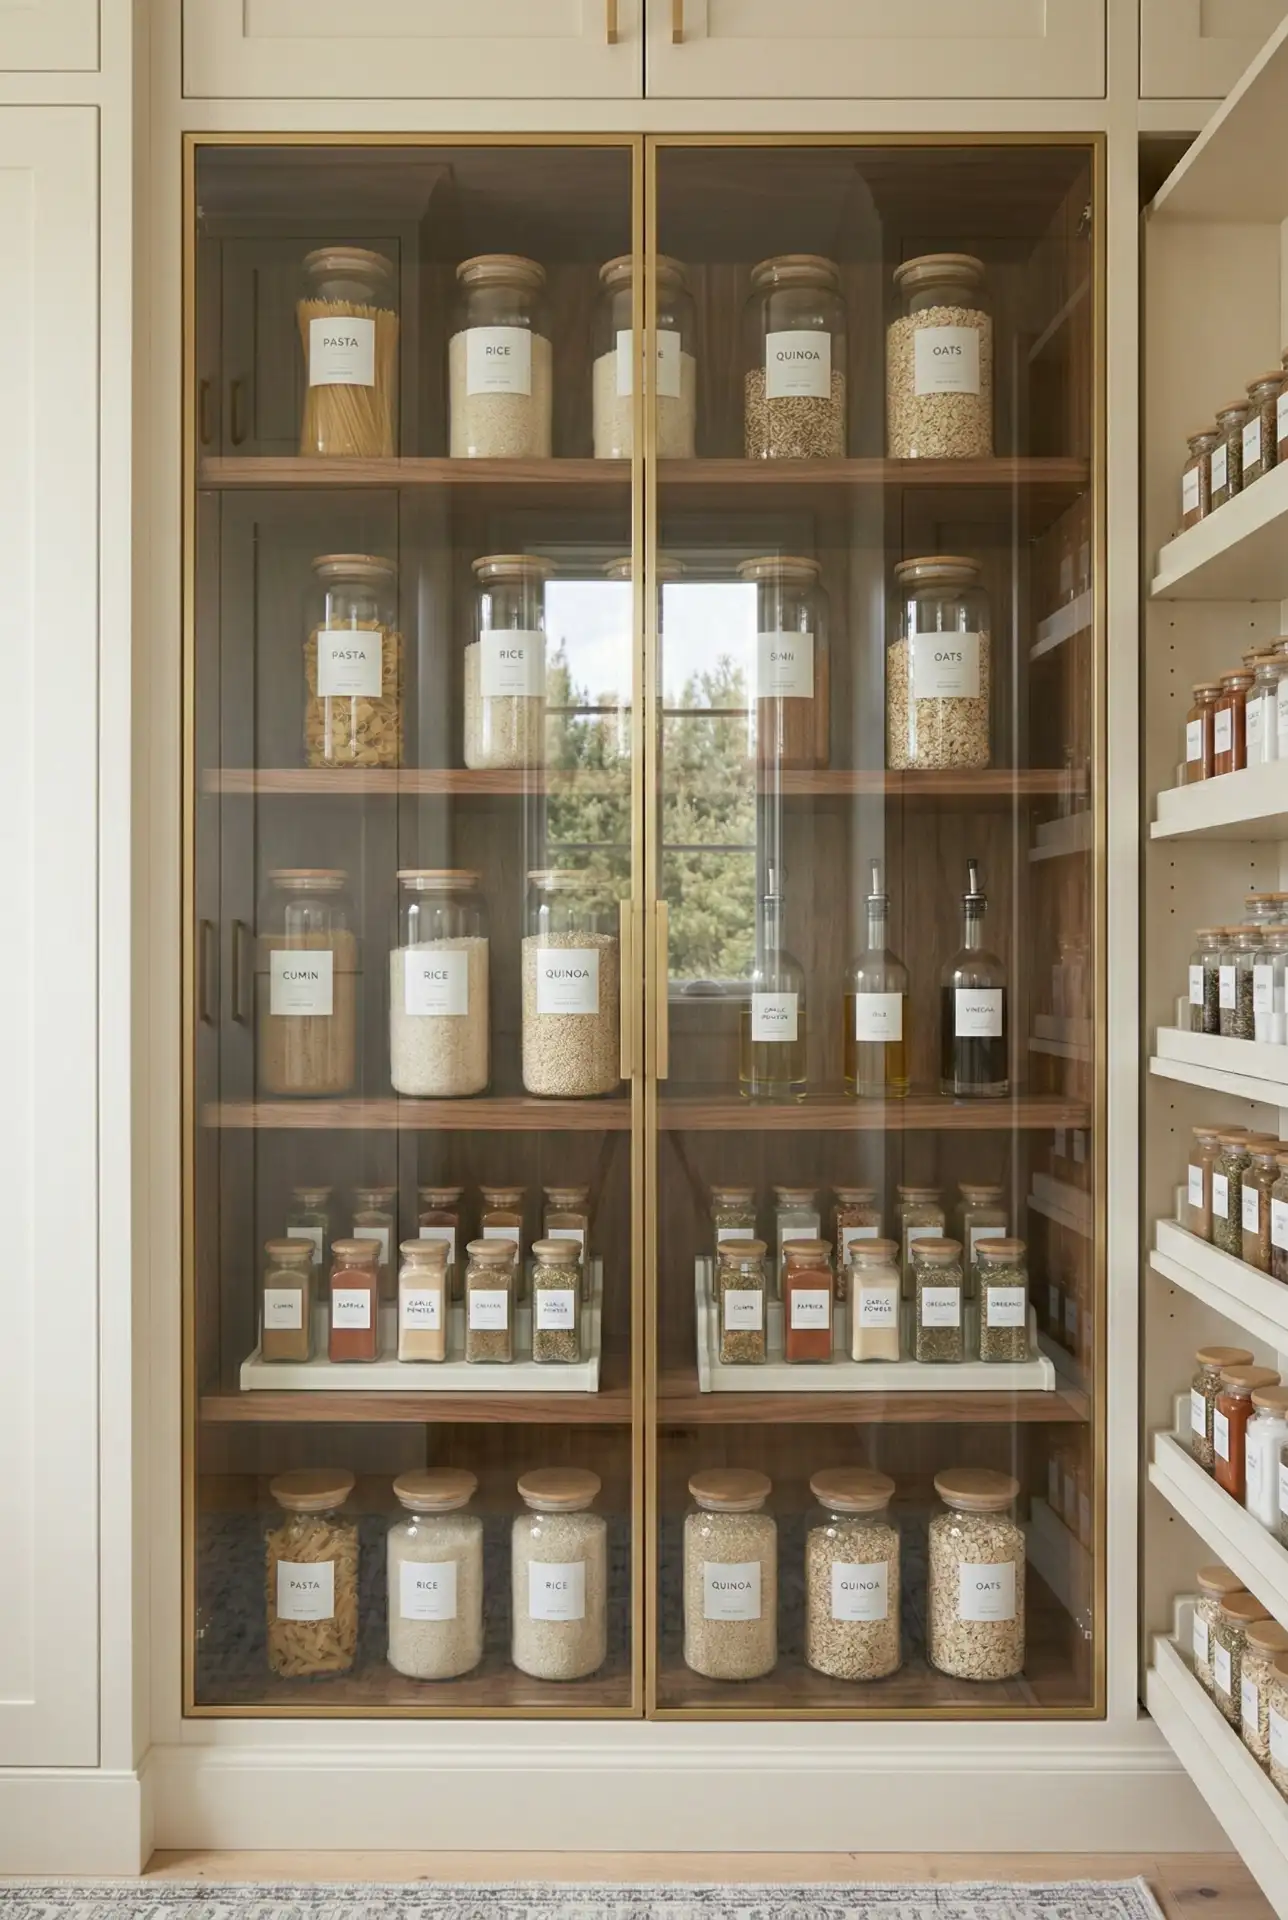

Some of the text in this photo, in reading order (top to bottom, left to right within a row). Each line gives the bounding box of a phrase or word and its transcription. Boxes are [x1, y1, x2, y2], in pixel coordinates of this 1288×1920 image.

[323, 337, 358, 348] PASTA
[486, 346, 511, 356] RICE
[933, 346, 962, 356] OATS
[776, 351, 820, 361] QUINOA
[332, 651, 366, 660] PASTA
[500, 650, 524, 659] RICE
[934, 652, 963, 661] OATS
[283, 971, 319, 980] CUMIN
[424, 970, 449, 980] RICE
[546, 969, 590, 979] QUINOA
[290, 1581, 320, 1590] PASTA
[416, 1581, 438, 1590] RICE
[545, 1581, 568, 1590] RICE
[712, 1581, 752, 1590] QUINOA
[840, 1581, 880, 1590] QUINOA
[976, 1582, 1002, 1590] OATS
